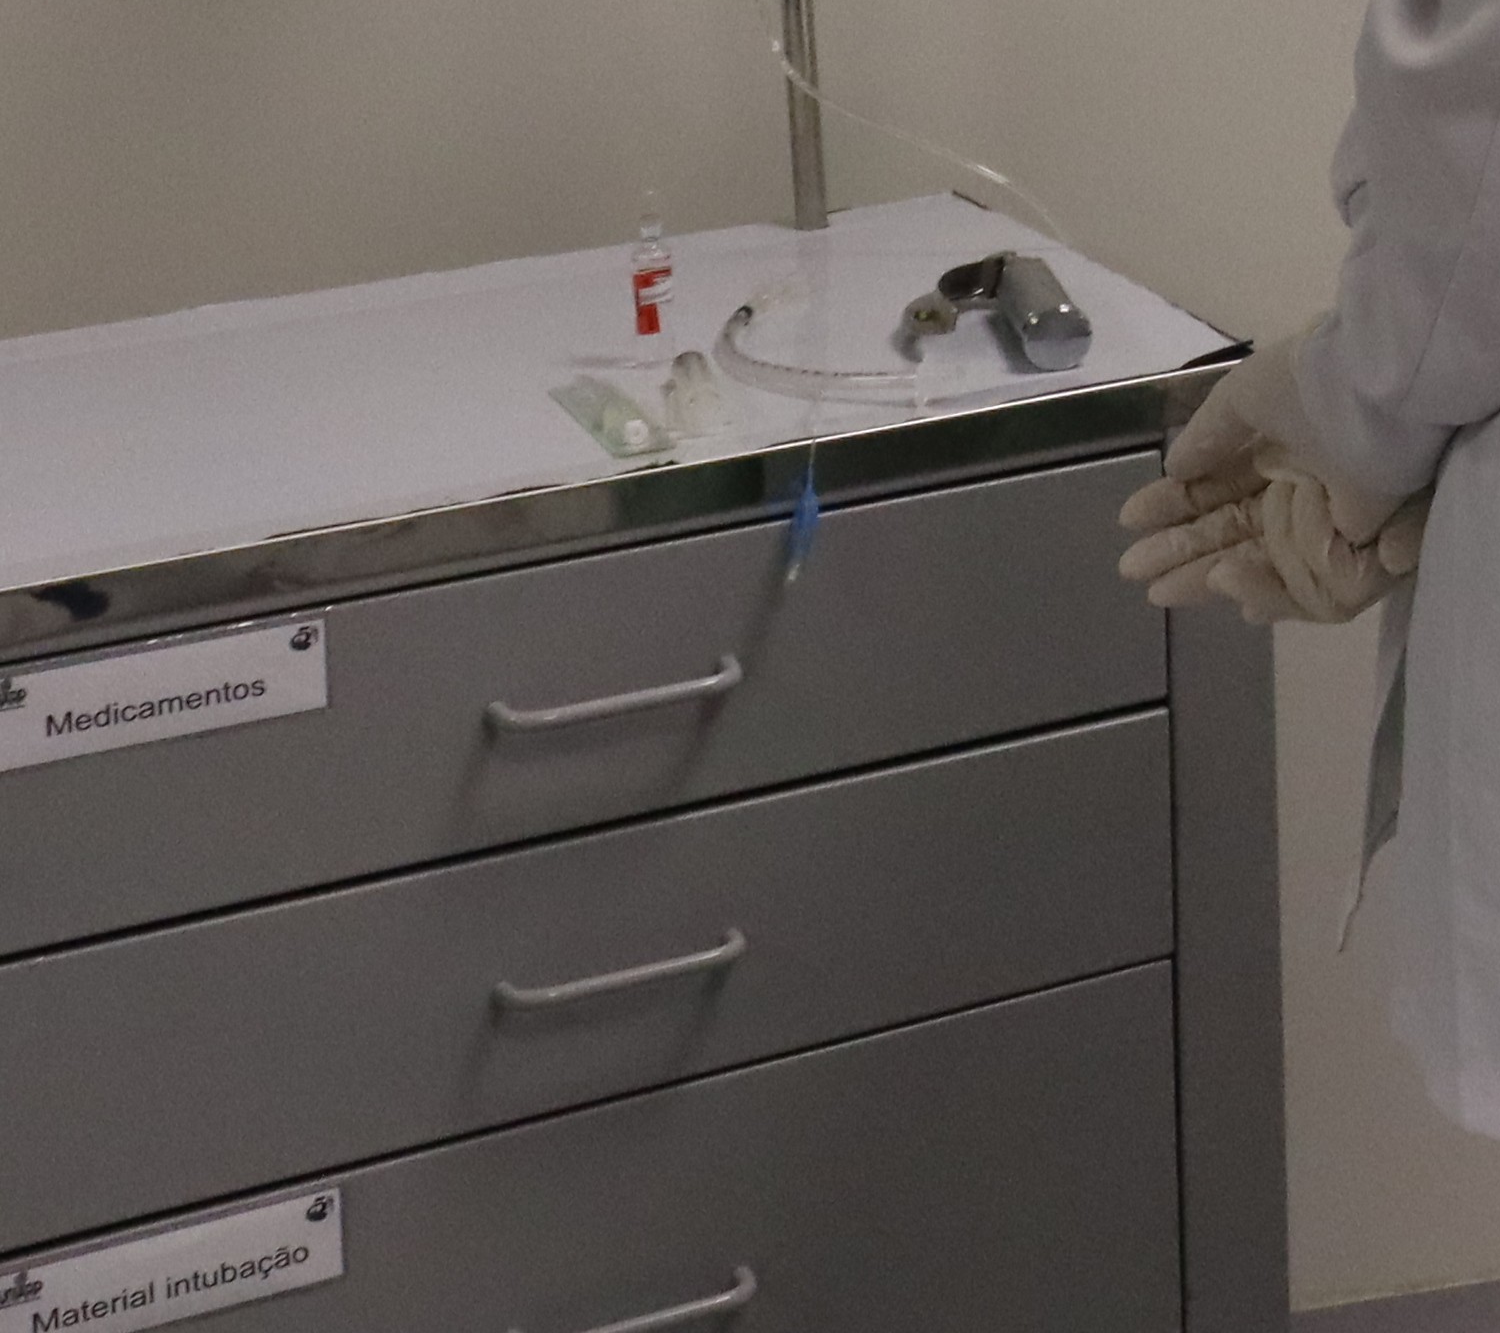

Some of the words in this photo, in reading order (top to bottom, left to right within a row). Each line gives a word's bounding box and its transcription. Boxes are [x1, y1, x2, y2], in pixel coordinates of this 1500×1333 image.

[45, 677, 266, 737] Medicamentos
[32, 1282, 155, 1333] Material
[165, 1244, 310, 1300] intubação
